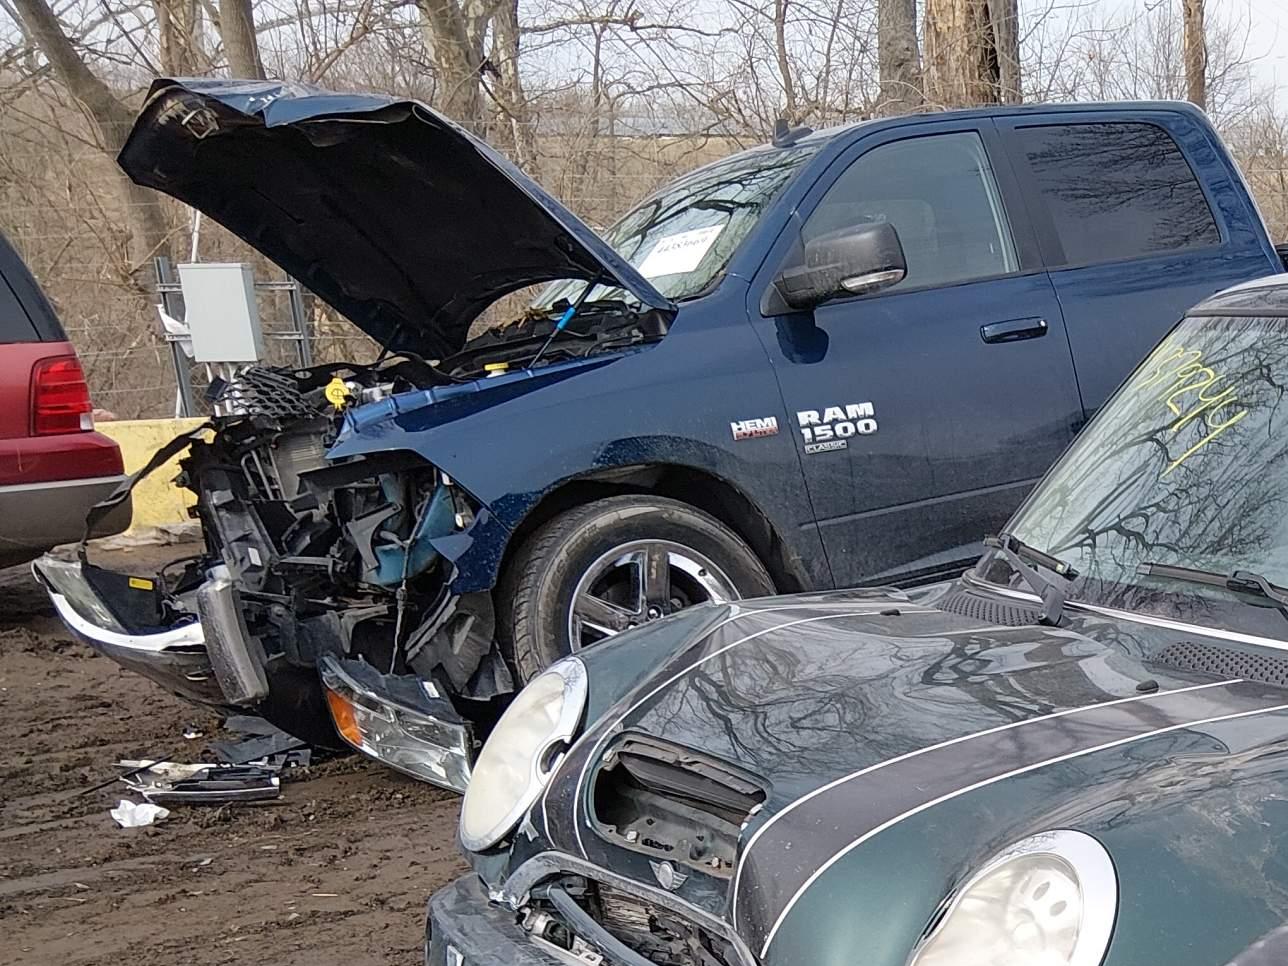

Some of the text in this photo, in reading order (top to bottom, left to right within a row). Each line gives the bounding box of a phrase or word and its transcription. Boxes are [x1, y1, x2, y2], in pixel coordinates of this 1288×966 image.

[730, 416, 777, 432] HEMI
[796, 402, 875, 426] RAM
[801, 418, 878, 444] 1500
